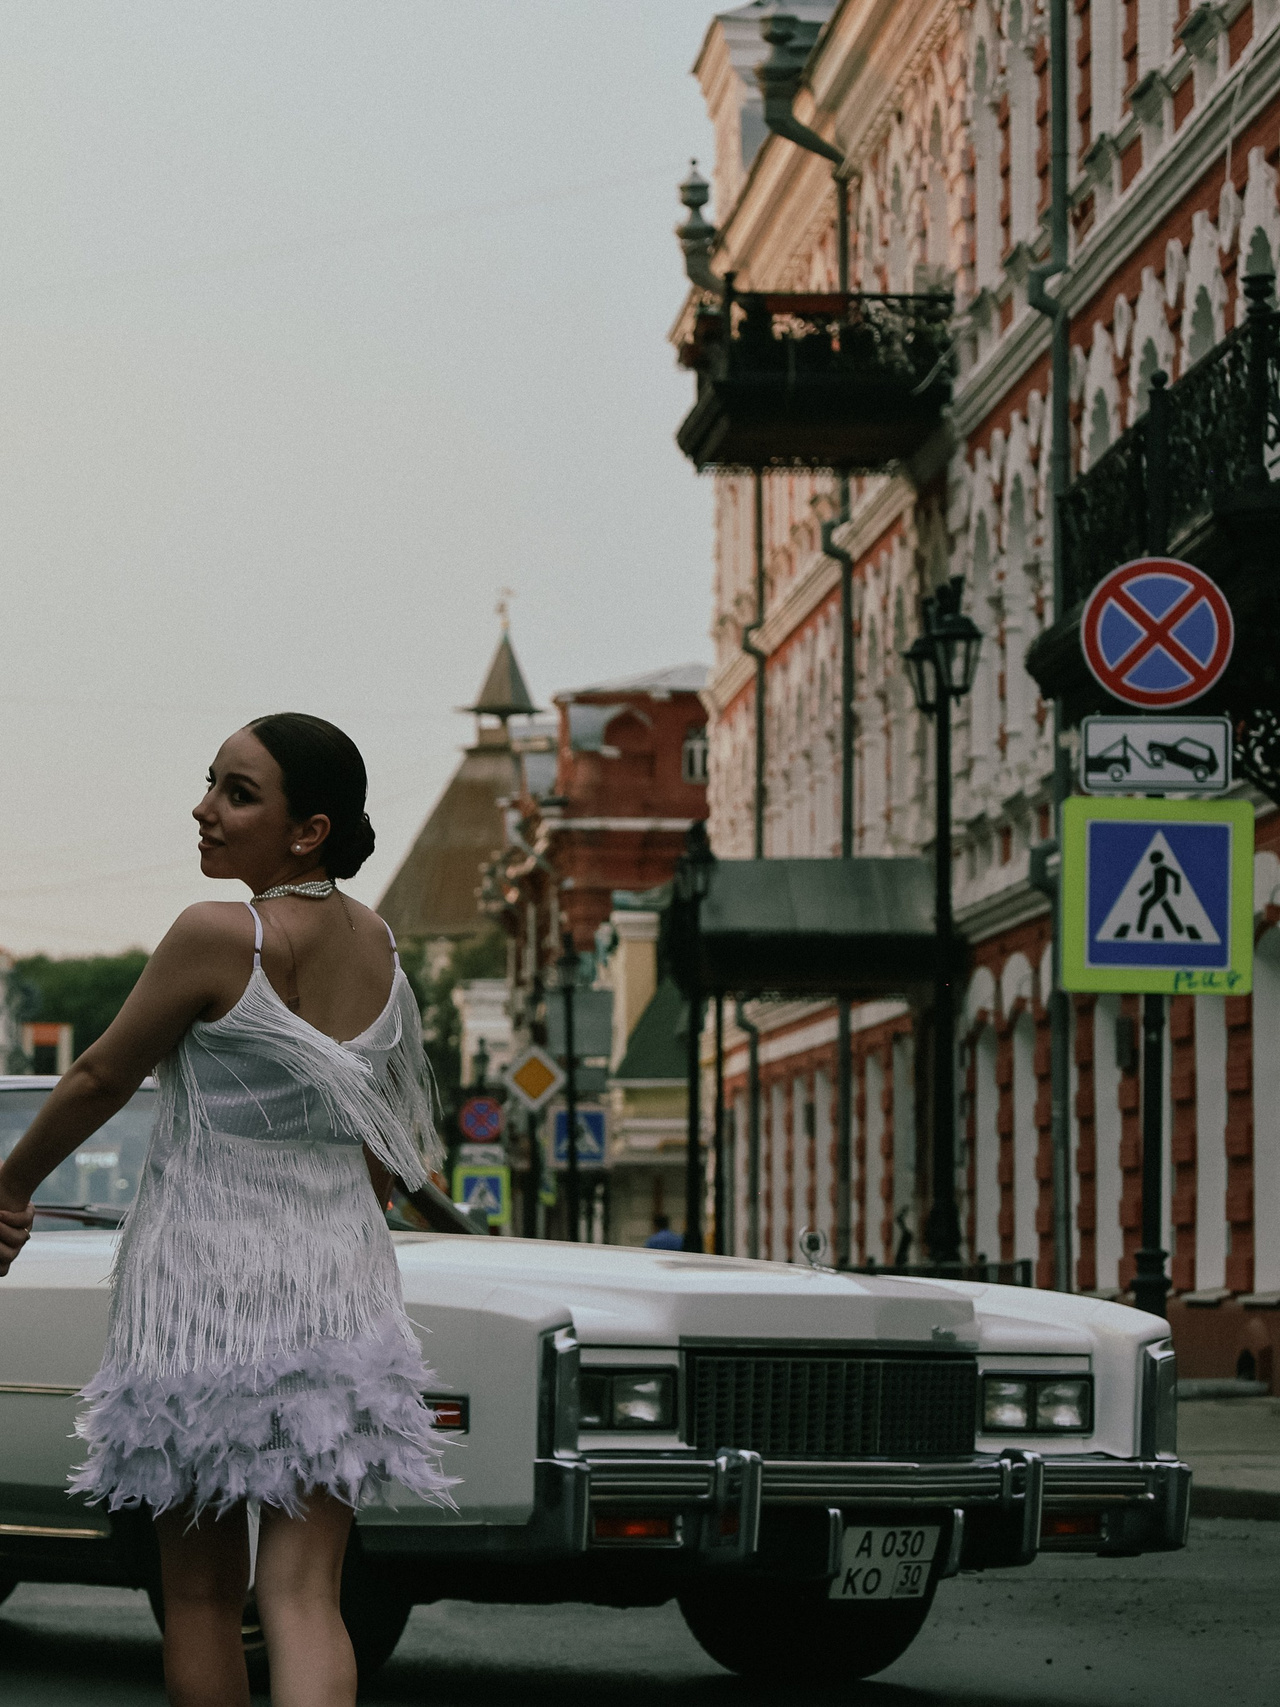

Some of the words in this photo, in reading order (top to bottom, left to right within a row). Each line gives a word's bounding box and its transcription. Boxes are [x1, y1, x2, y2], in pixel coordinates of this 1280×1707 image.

[855, 1530, 872, 1558] A
[882, 1530, 925, 1557] 030
[842, 1568, 881, 1595] KO
[899, 1565, 922, 1586] 30
